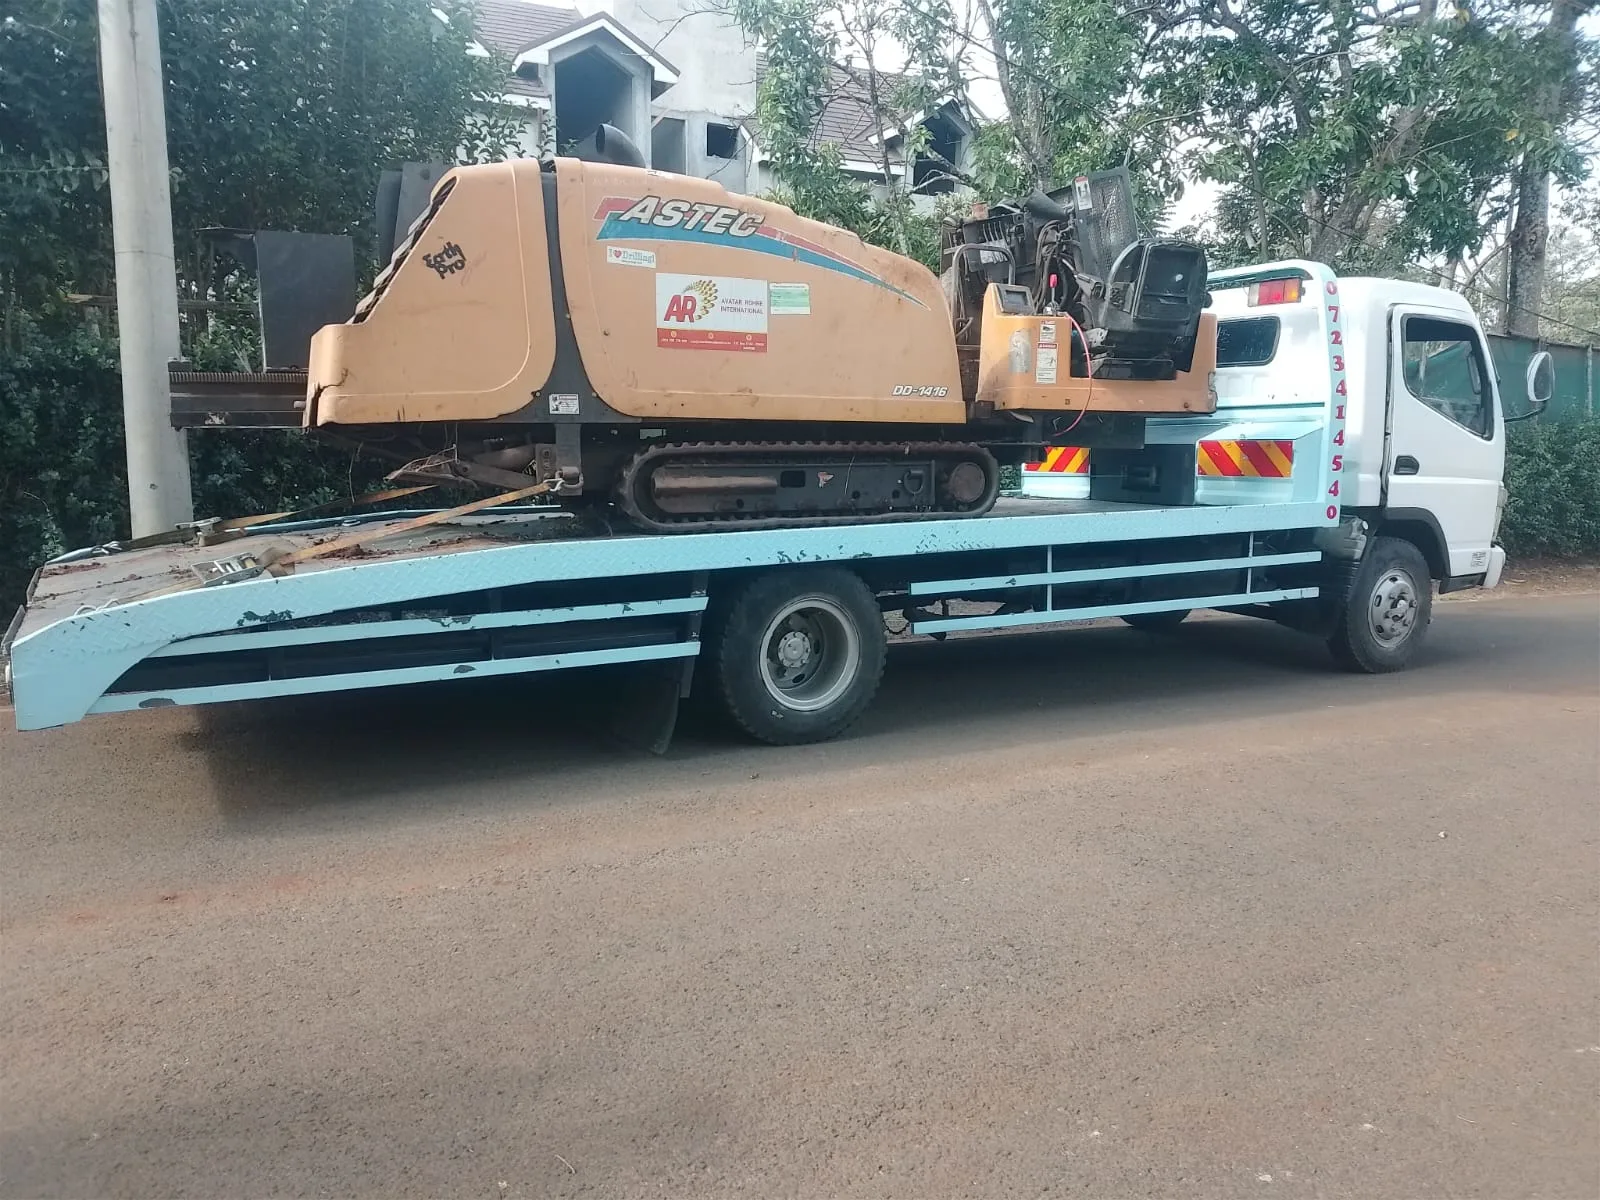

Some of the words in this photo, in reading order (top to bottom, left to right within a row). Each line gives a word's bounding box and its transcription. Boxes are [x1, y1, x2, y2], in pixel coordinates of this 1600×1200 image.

[619, 195, 765, 237] ASTEC
[663, 294, 697, 323] AR
[720, 297, 743, 306] AVATAR
[720, 305, 765, 315] INTERNATIONAL
[892, 384, 948, 398] DD-1416
